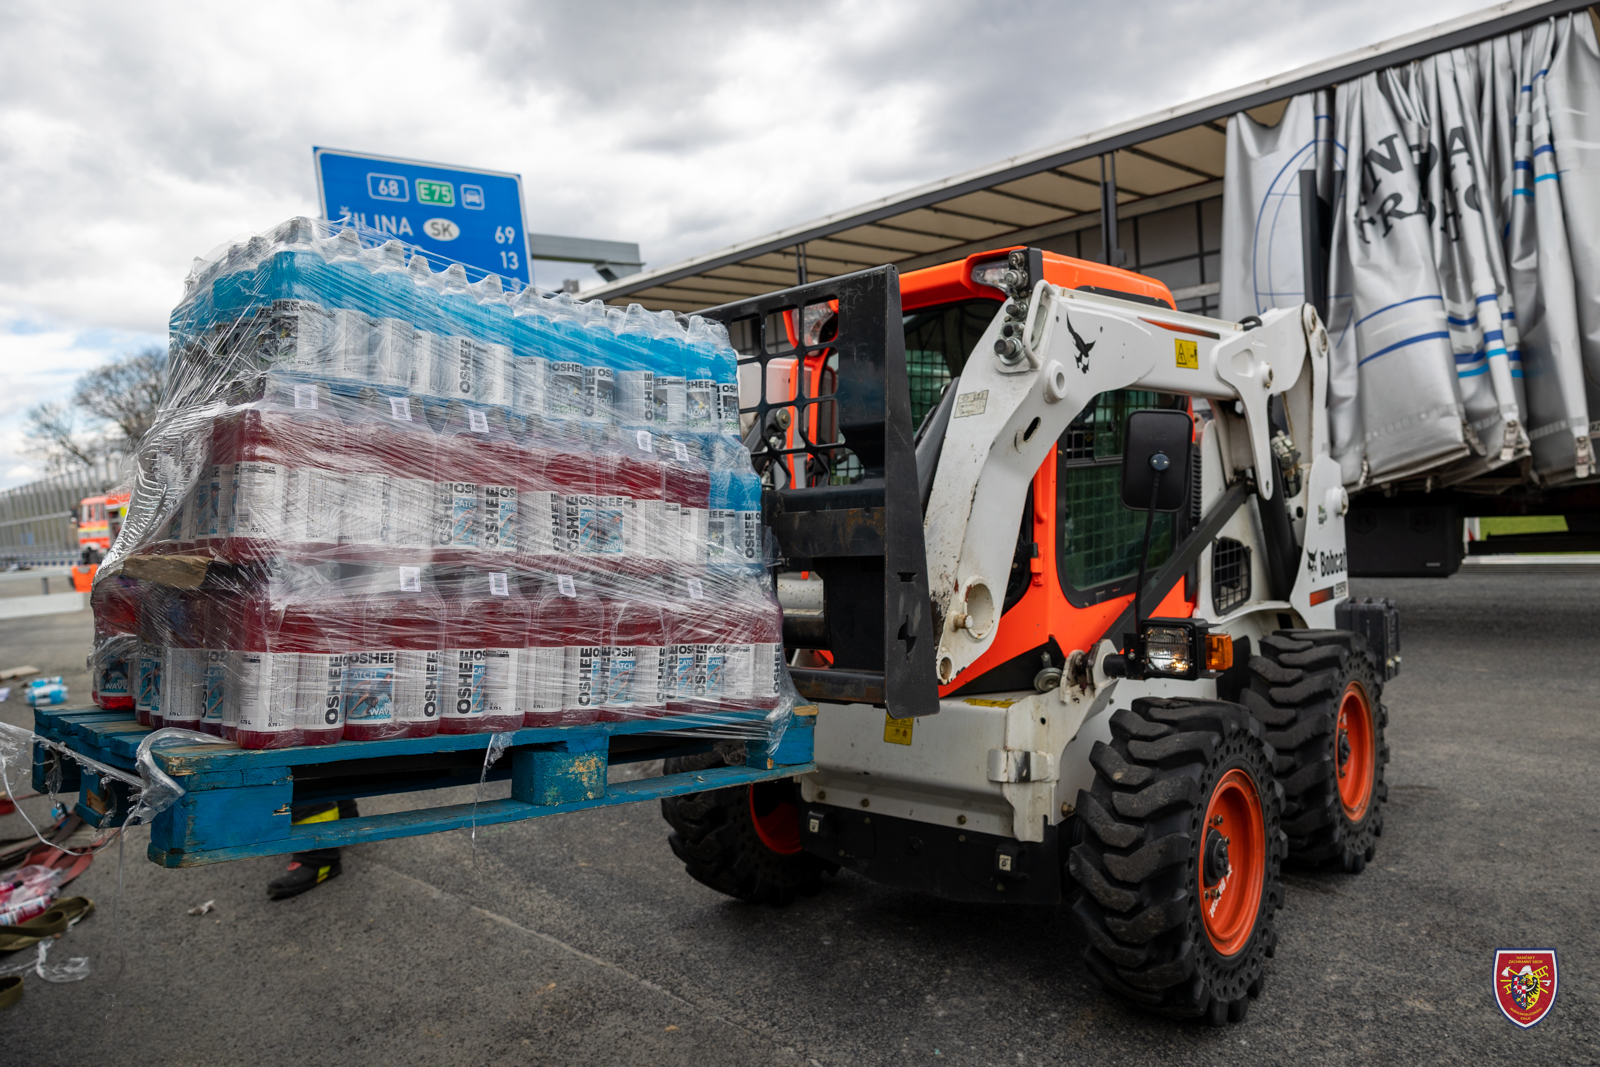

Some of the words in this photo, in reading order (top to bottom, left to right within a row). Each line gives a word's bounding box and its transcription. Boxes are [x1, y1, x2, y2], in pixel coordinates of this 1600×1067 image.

[378, 179, 400, 196] 68
[419, 183, 451, 202] E75
[339, 206, 414, 237] ŽILINA
[430, 221, 454, 237] SK
[495, 226, 515, 245] 69
[500, 251, 519, 270] 13
[644, 372, 653, 421] OSHEE
[566, 495, 579, 553] OSHEE
[745, 512, 754, 559] OSHEE
[612, 647, 636, 657] OSH
[325, 655, 342, 725] OSHEE
[424, 651, 438, 717] OSHEE
[457, 650, 473, 714] OSHEE
[578, 647, 592, 706] OSHEE
